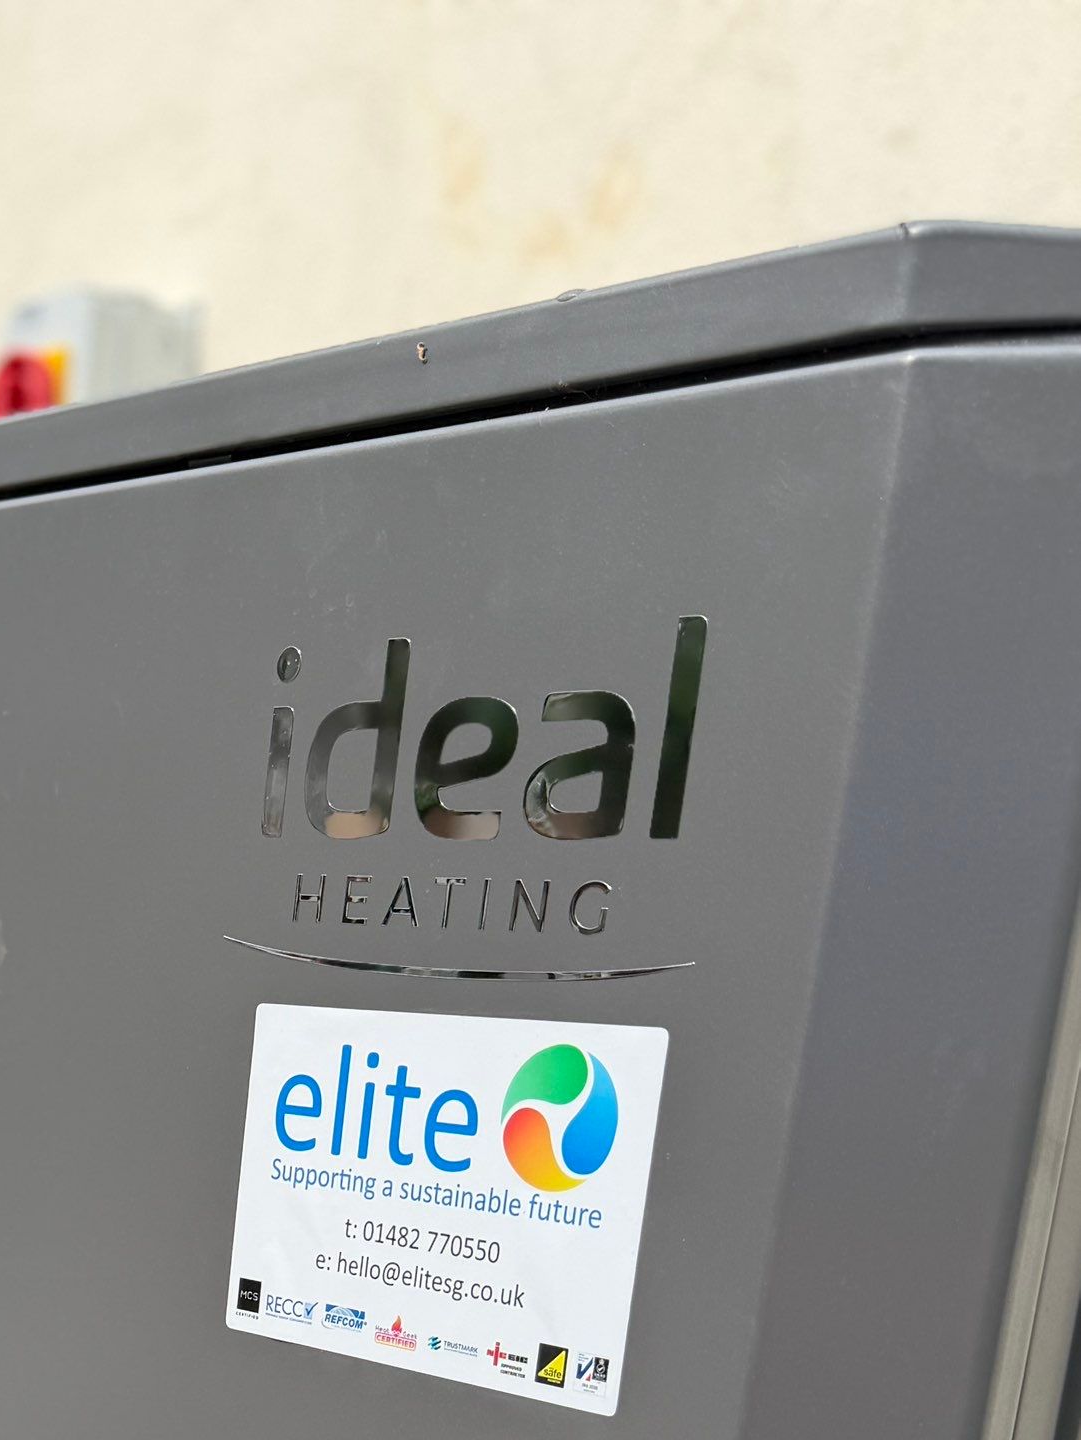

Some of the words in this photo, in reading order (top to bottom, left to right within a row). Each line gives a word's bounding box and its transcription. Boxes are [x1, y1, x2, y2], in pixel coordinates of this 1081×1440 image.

[261, 614, 708, 840] ideal
[292, 873, 612, 935] HEATING
[275, 1044, 479, 1172] elite
[271, 1158, 376, 1200] Supporting
[382, 1179, 393, 1197] a
[399, 1182, 521, 1217] sustainable
[529, 1193, 602, 1229] future
[345, 1219, 357, 1239] t:
[363, 1221, 420, 1250] 01482
[427, 1231, 501, 1264] 770550
[240, 1289, 259, 1302] MCS
[265, 1294, 304, 1317] RECC
[315, 1253, 331, 1271] e:
[337, 1252, 525, 1308] hello@elitesg.co.uk
[376, 1334, 415, 1349] CERTIFIED
